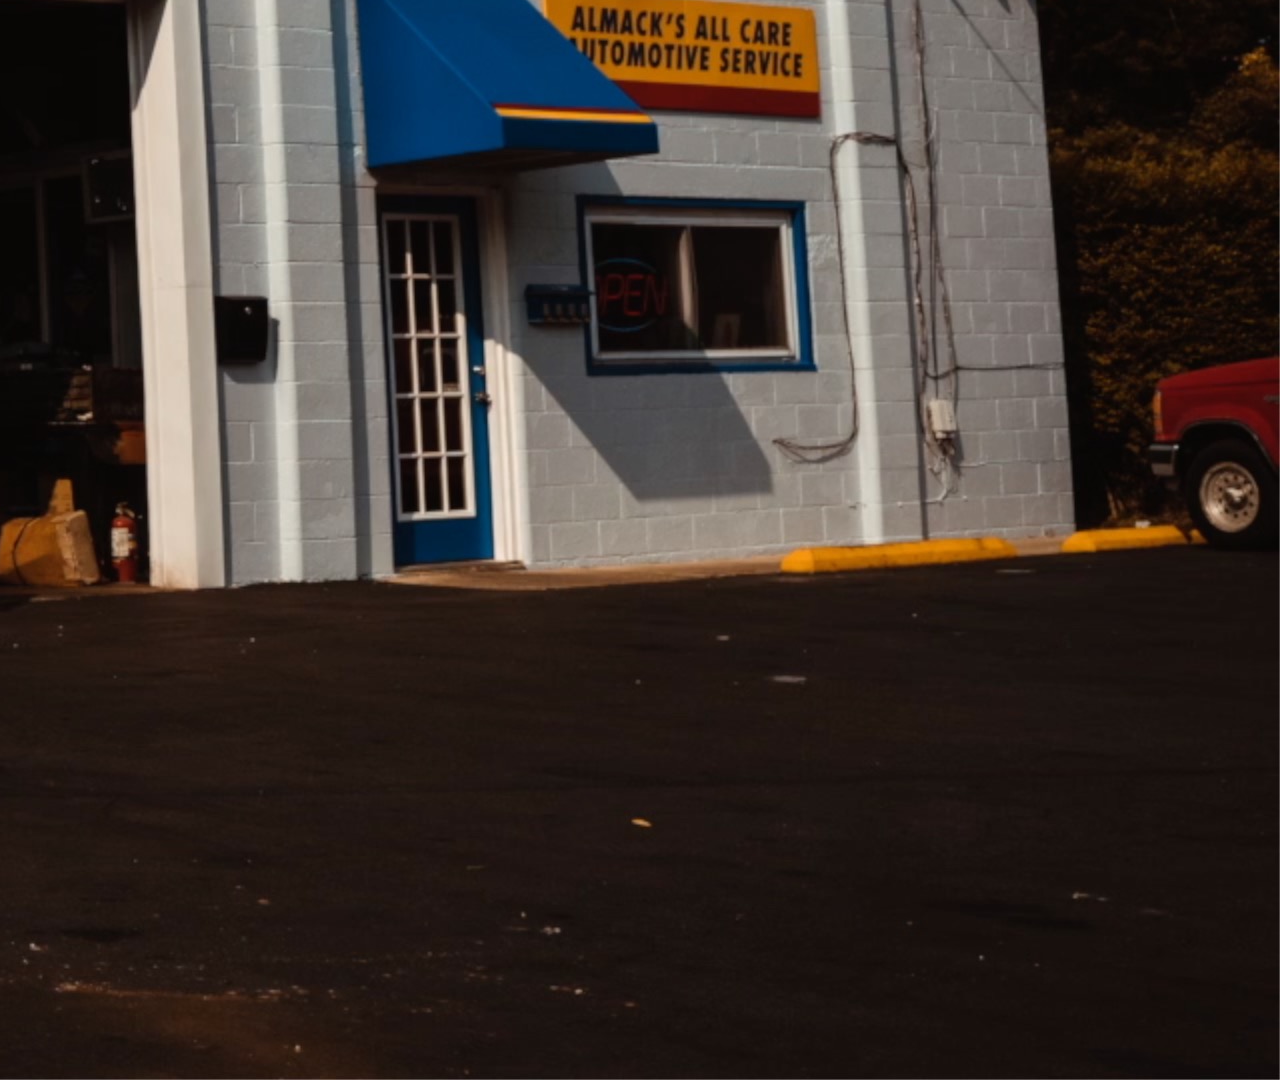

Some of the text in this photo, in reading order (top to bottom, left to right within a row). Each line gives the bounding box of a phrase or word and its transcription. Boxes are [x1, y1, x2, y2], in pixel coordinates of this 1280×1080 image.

[571, 6, 792, 46] ALMACK'S ALL CARE
[720, 52, 803, 78] SERVICE
